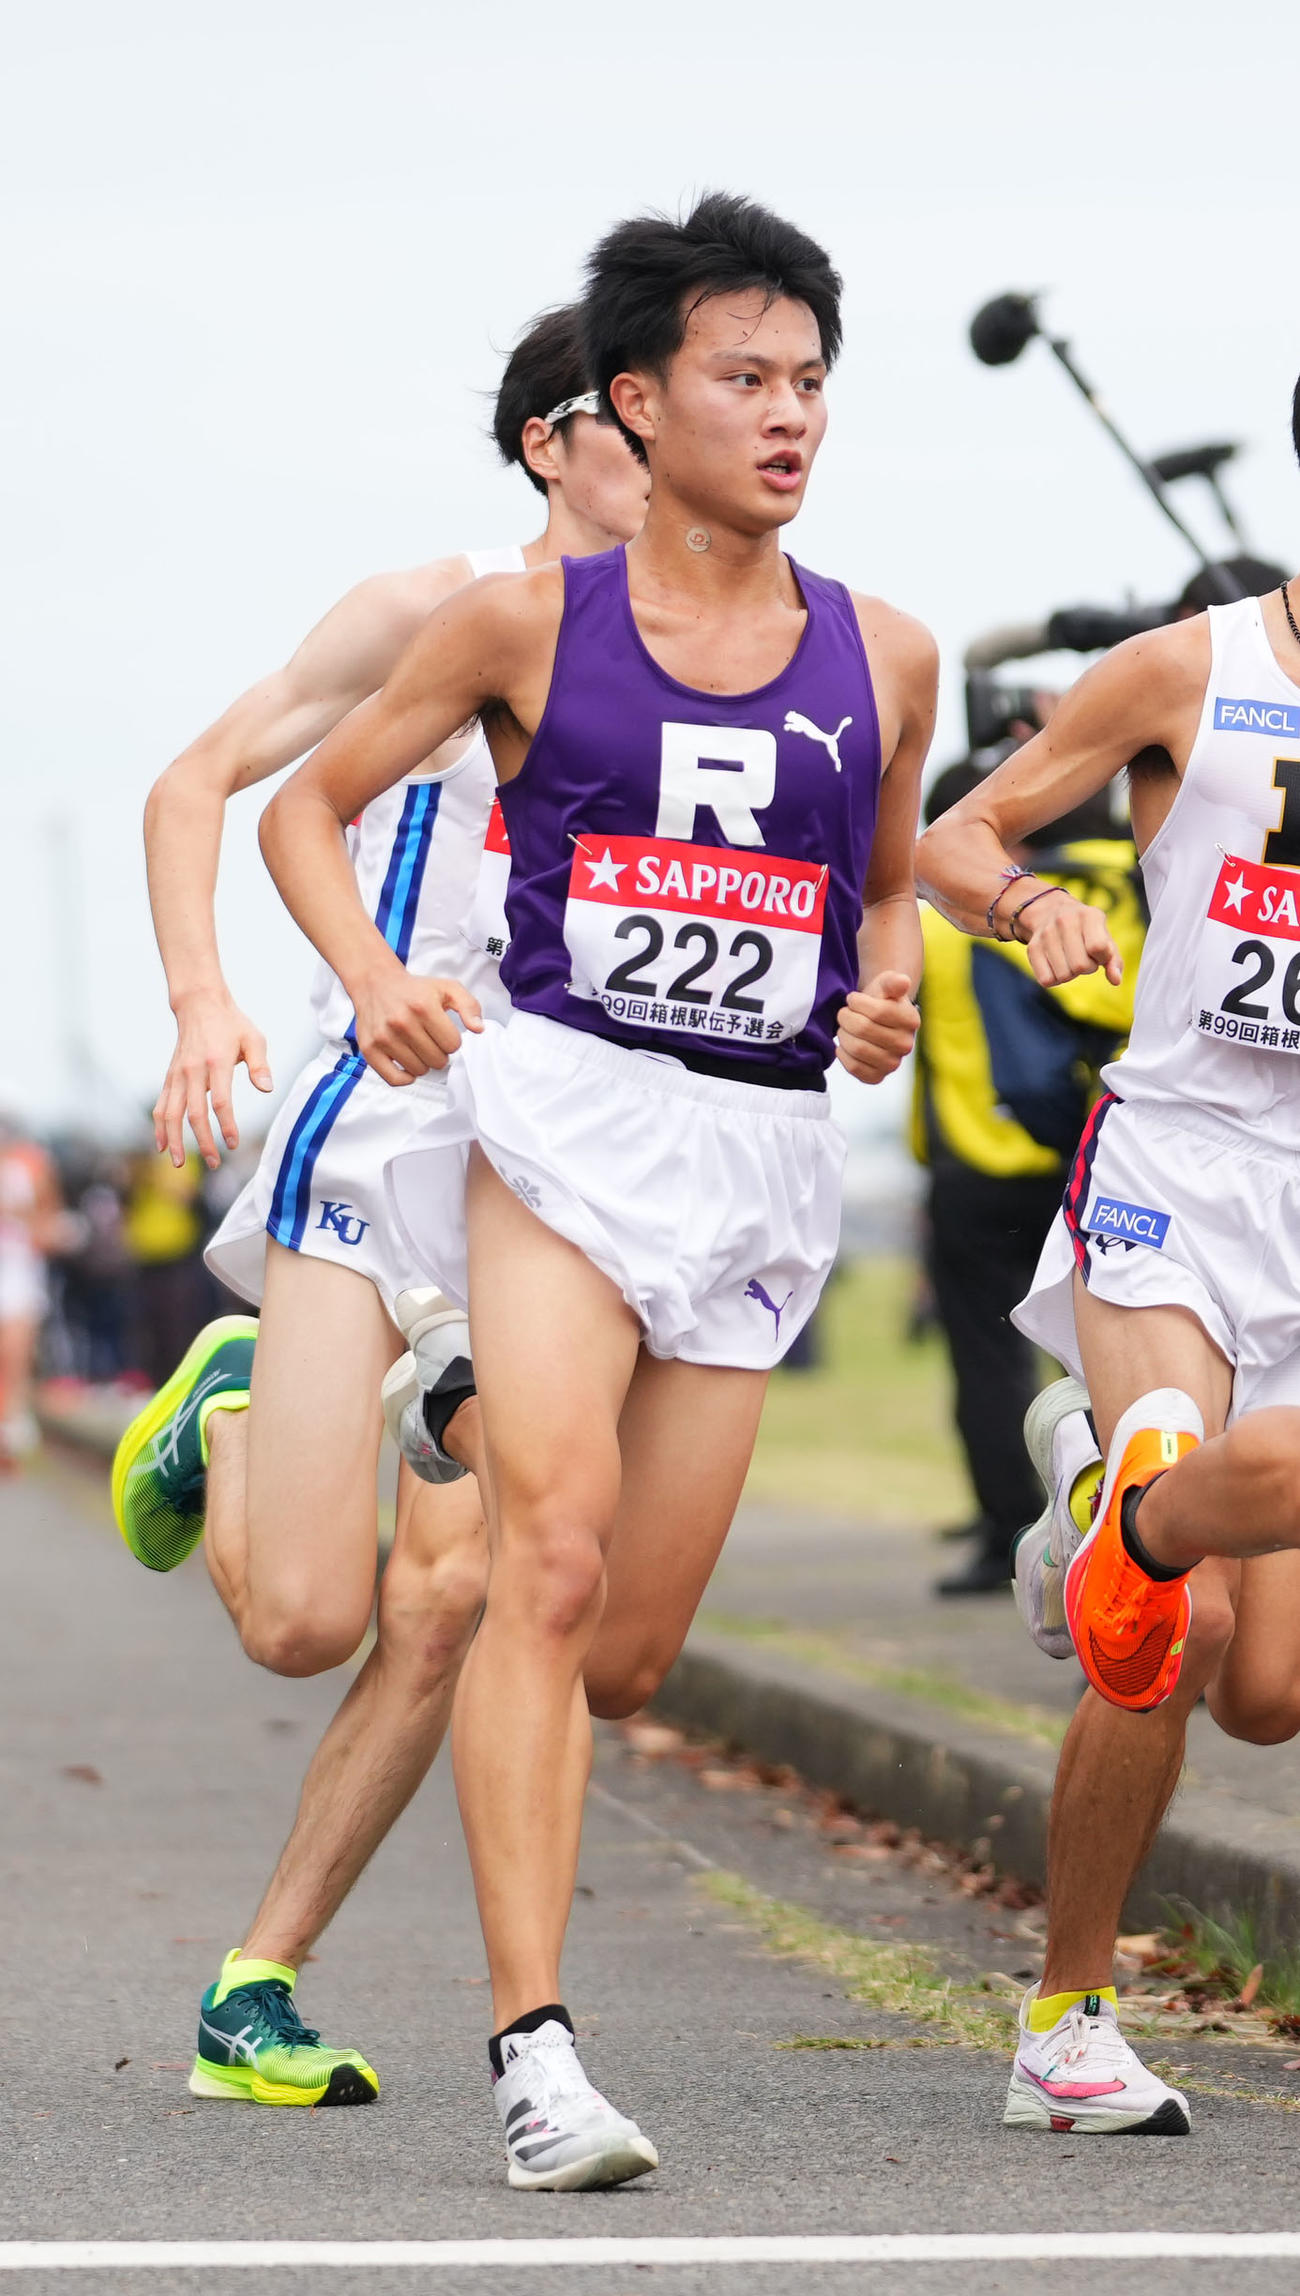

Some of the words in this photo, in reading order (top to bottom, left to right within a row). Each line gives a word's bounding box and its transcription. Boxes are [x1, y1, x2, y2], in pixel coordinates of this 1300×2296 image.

[1220, 704, 1296, 732] FANCL
[655, 721, 777, 847] R
[635, 855, 817, 918] SAPPORO
[1257, 885, 1300, 927] SA
[605, 914, 774, 1014] 222
[592, 985, 785, 1040] 99回箱根駅伝予選会
[1198, 1008, 1300, 1050] 第99回箱根
[315, 1200, 371, 1246] KU
[1094, 1204, 1160, 1240] FANCL
